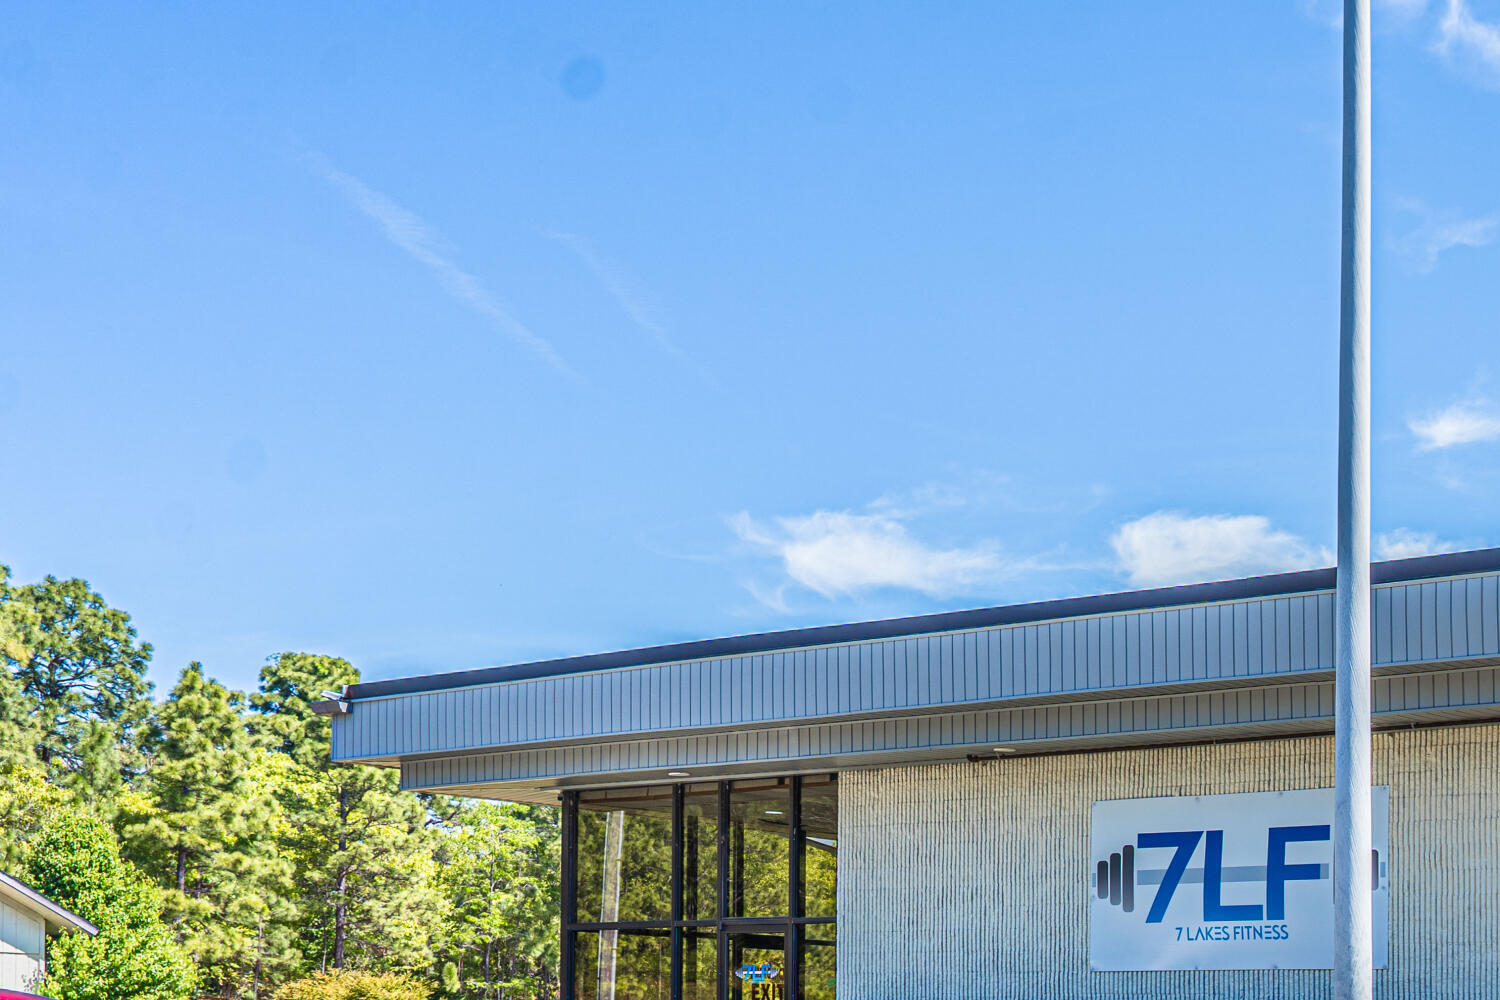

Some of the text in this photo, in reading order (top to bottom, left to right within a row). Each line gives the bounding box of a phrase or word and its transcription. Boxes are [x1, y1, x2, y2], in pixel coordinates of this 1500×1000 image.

[1137, 824, 1331, 924] 7LF
[1175, 924, 1289, 941] 7 LAKES FITNESS
[741, 964, 771, 981] 7LF
